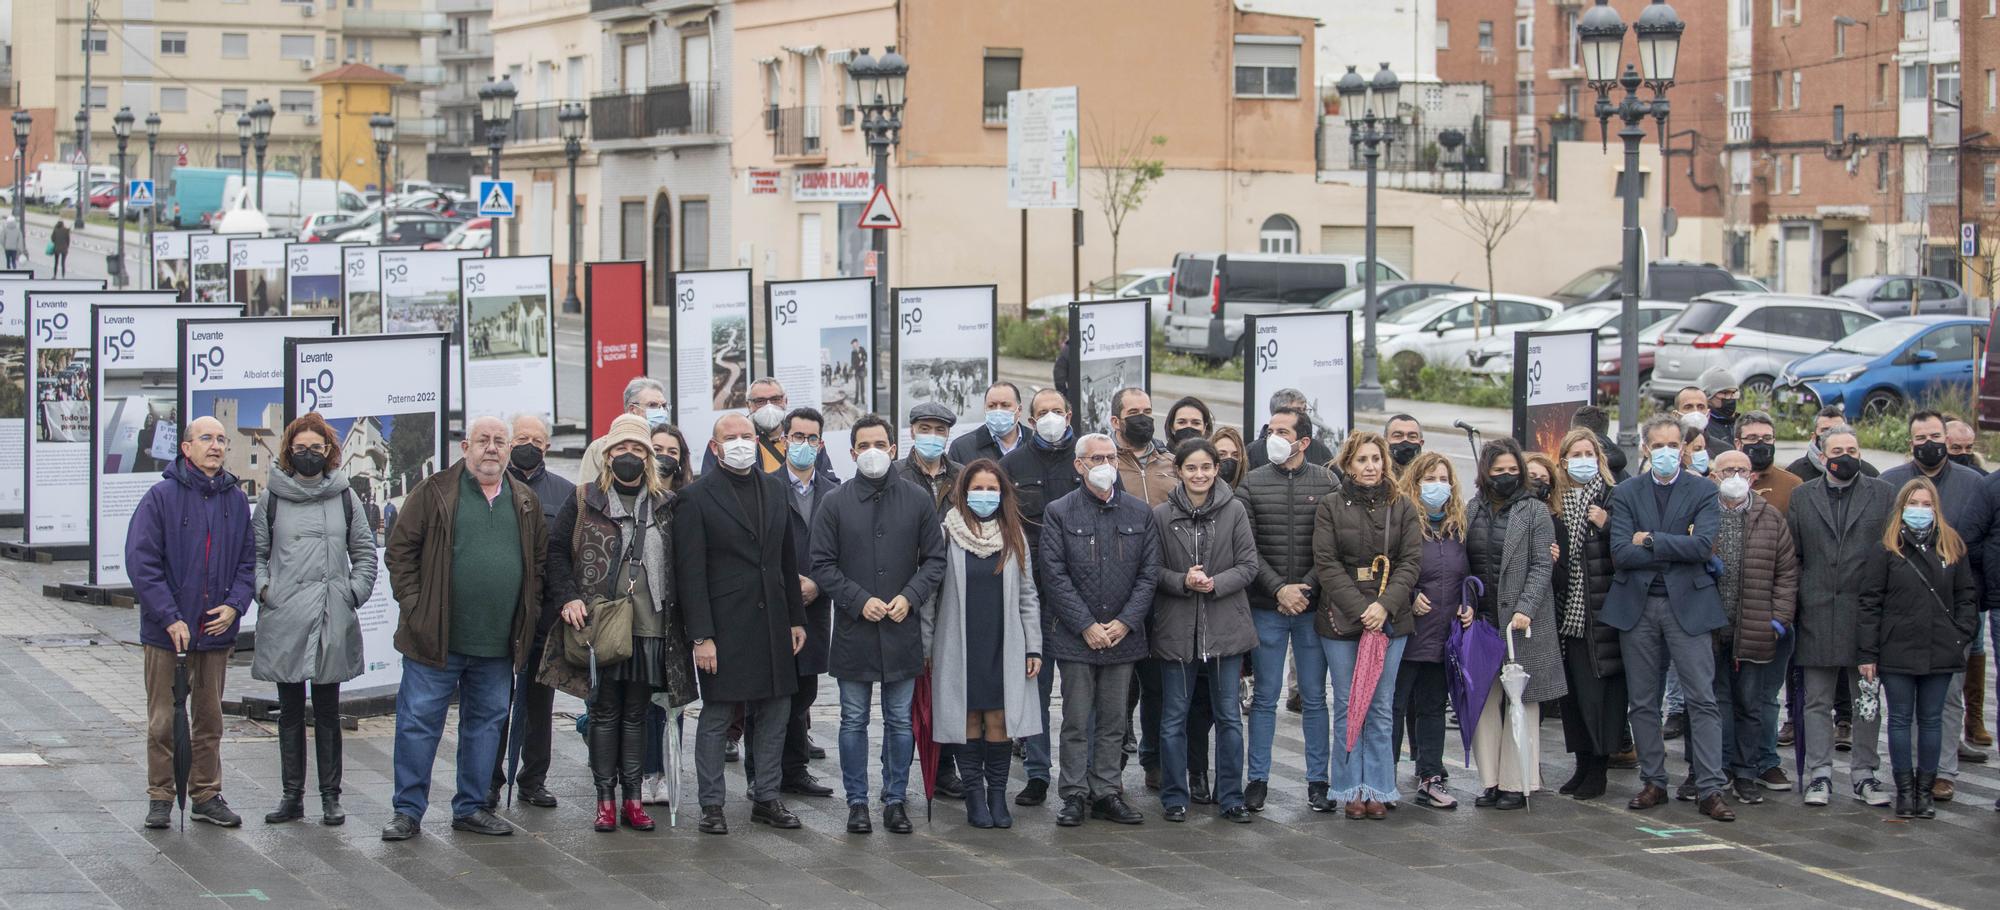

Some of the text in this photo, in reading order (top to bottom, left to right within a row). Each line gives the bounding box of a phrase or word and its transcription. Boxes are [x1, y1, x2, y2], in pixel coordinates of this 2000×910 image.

[802, 171, 869, 189] ASADOR EL PALACIO
[194, 245, 210, 262] 150
[232, 250, 248, 267] 150
[291, 255, 309, 273] 150
[348, 259, 366, 278] 150
[385, 264, 408, 284] 150
[466, 272, 486, 293] 150
[36, 300, 68, 309] Levante
[678, 288, 695, 312] 150
[104, 315, 135, 324] Levante
[775, 299, 797, 325] 150
[901, 307, 922, 336] 150
[37, 313, 69, 342] 150
[192, 331, 224, 341] Levante
[1257, 325, 1278, 334] Levante
[104, 329, 135, 362] 150
[1080, 324, 1095, 354] 50
[192, 346, 224, 383] 150
[301, 352, 333, 363] Levante
[1256, 339, 1278, 372] 150
[243, 369, 270, 378] Albalat
[301, 369, 334, 411] 150
[387, 391, 436, 404] Paterna 2022
